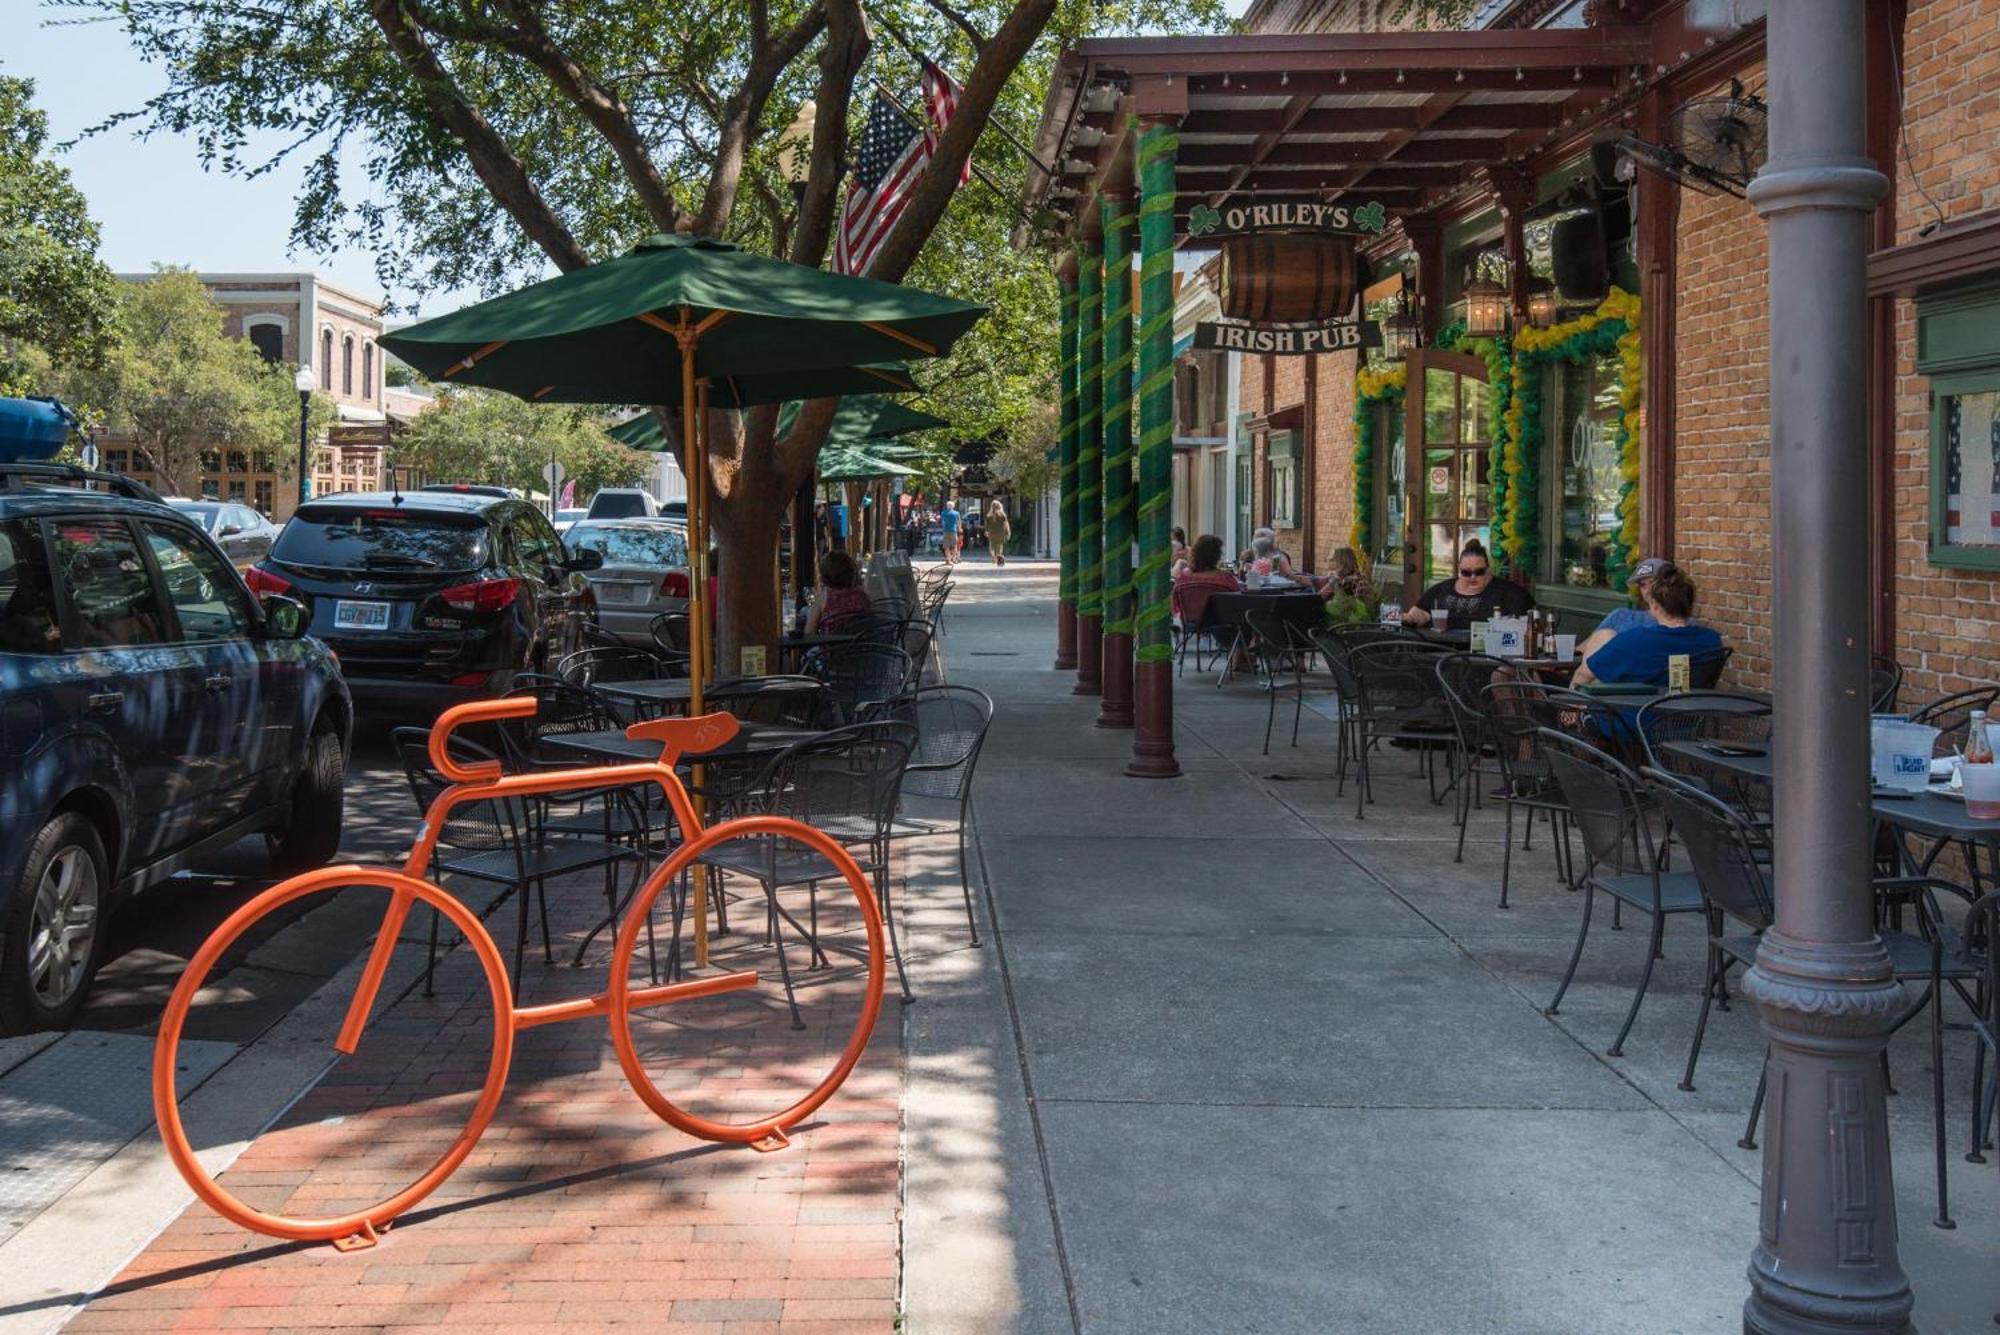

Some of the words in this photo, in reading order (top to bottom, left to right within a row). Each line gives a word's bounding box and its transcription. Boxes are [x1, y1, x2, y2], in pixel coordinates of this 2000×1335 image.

[1226, 203, 1349, 230] O'RILEY'S
[1215, 326, 1294, 351] IRISH
[1302, 325, 1361, 350] PUB
[1896, 764, 1925, 773] LIGHT
